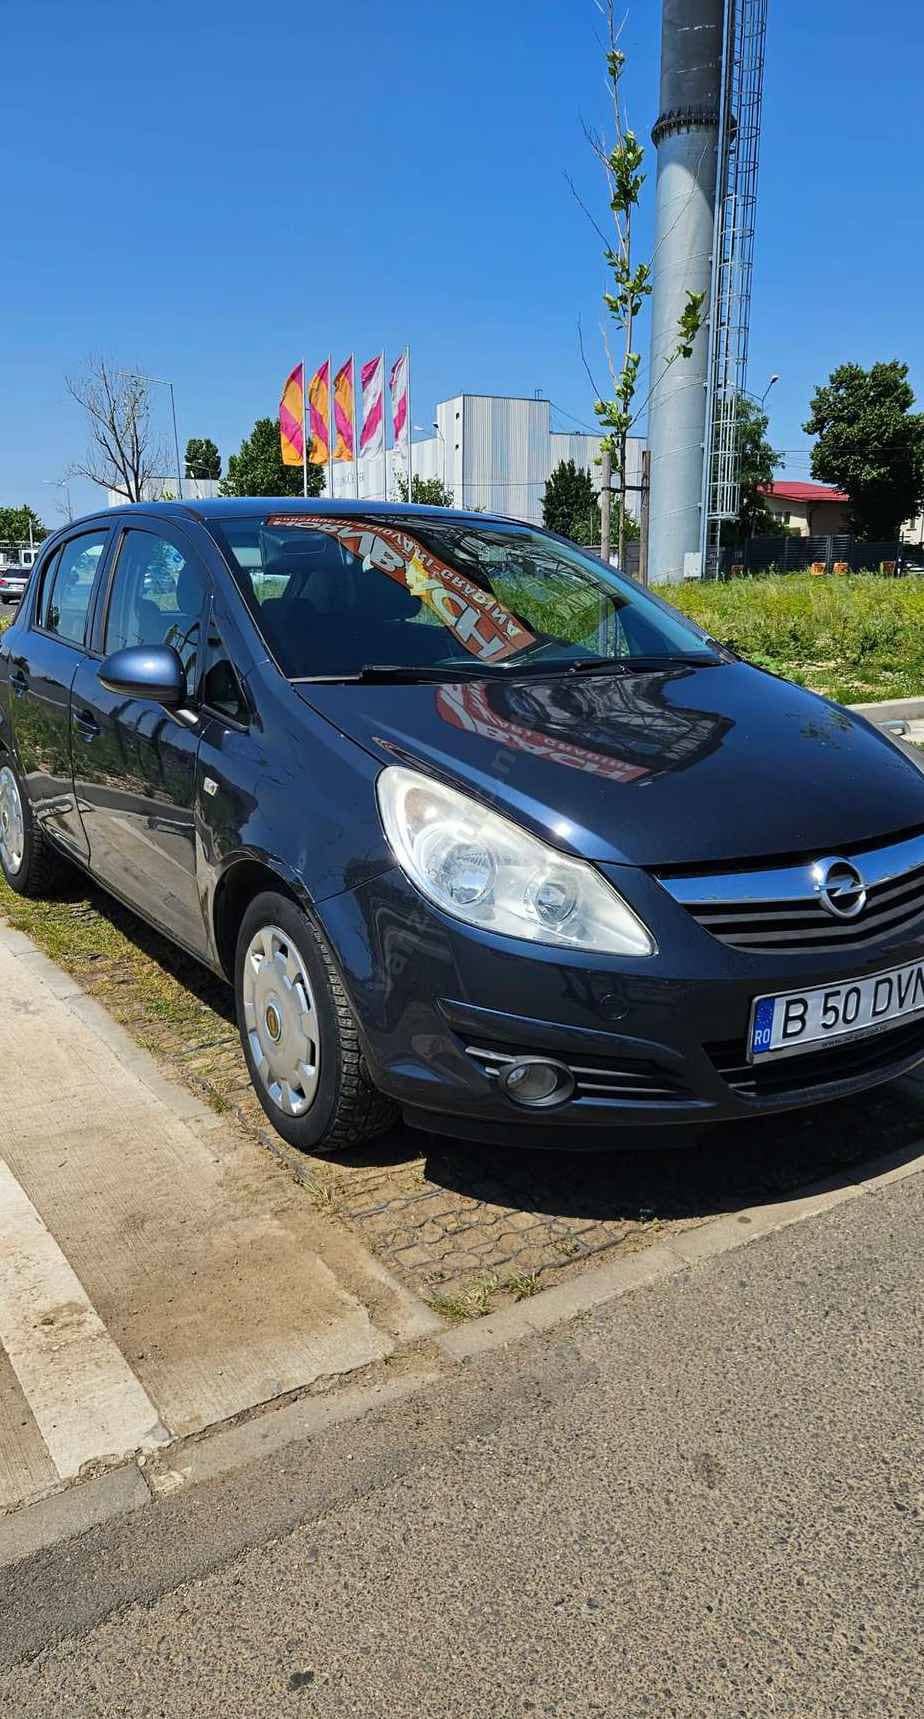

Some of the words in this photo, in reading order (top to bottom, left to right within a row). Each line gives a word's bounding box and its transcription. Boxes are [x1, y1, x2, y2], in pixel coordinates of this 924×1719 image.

[781, 997, 808, 1039] B
[821, 986, 861, 1029] 50
[753, 1028, 771, 1046] RO
